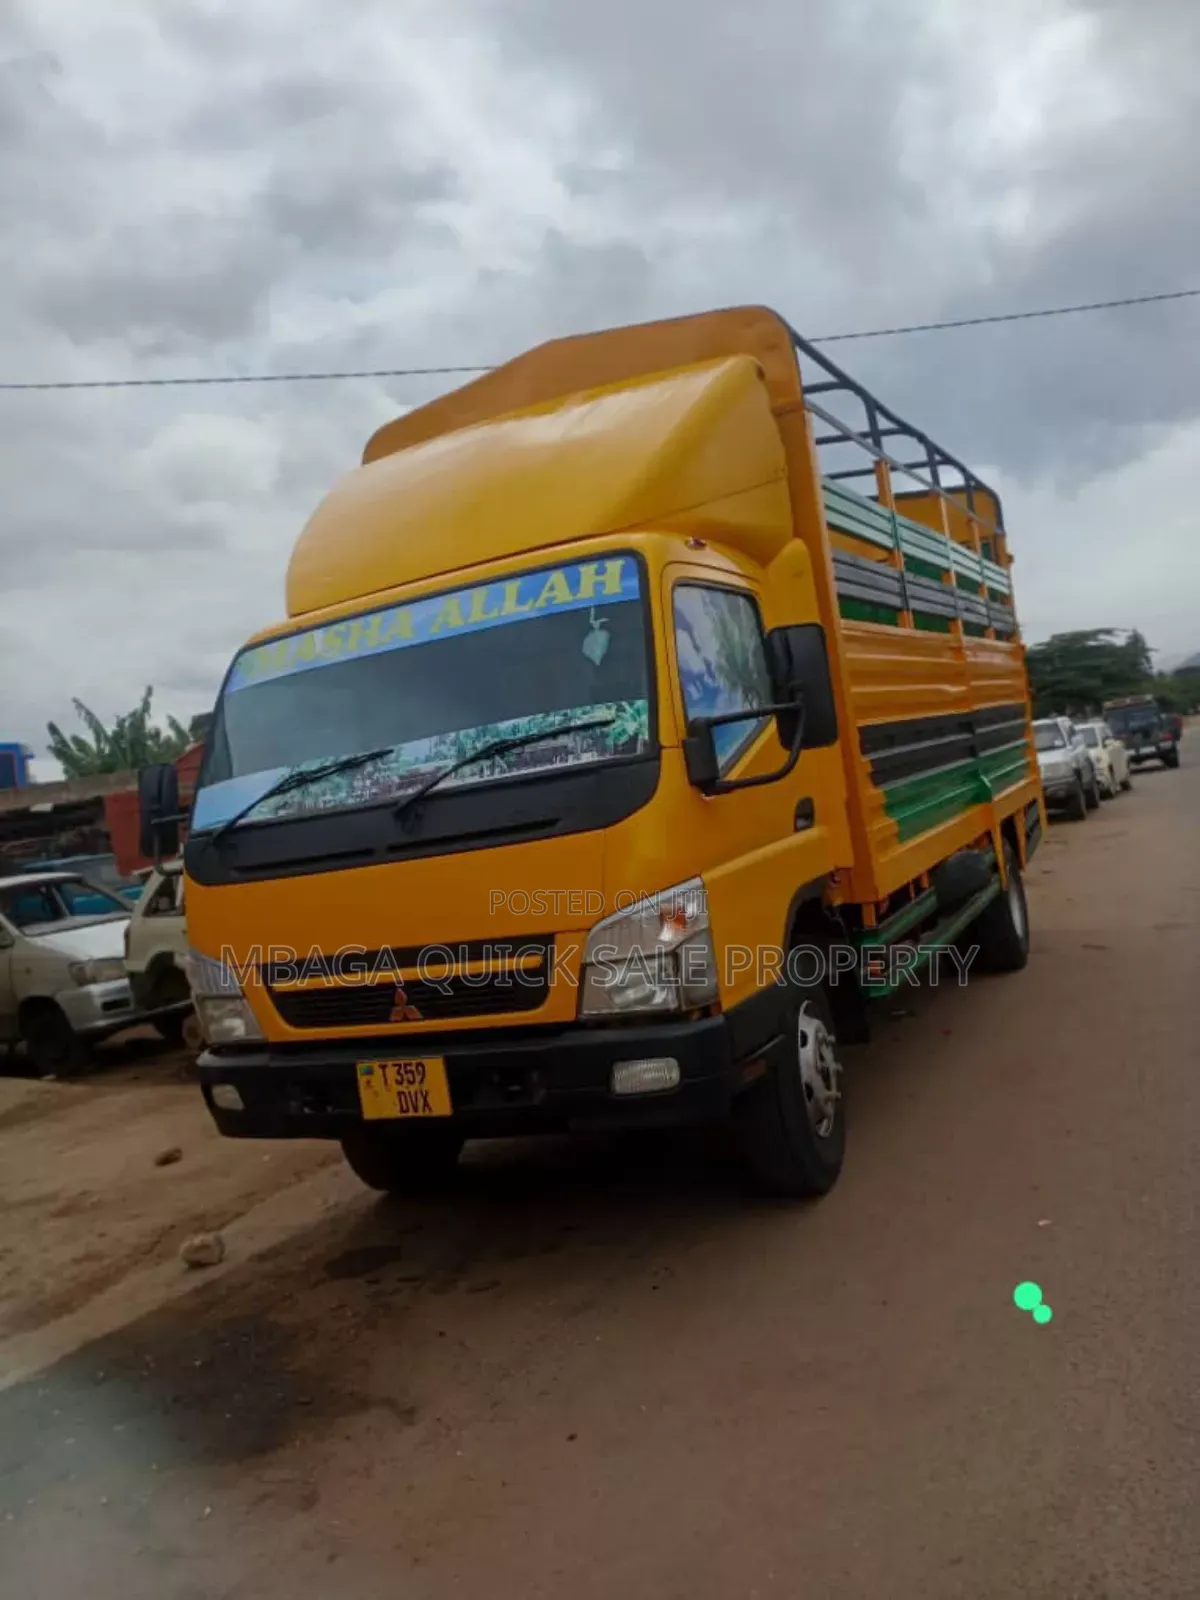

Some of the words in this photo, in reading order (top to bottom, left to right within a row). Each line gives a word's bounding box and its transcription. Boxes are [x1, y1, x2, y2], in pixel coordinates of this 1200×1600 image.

[430, 558, 625, 634] ALLAH
[378, 1063, 389, 1087] T
[392, 1061, 426, 1086] 359
[397, 1088, 433, 1114] DVX
